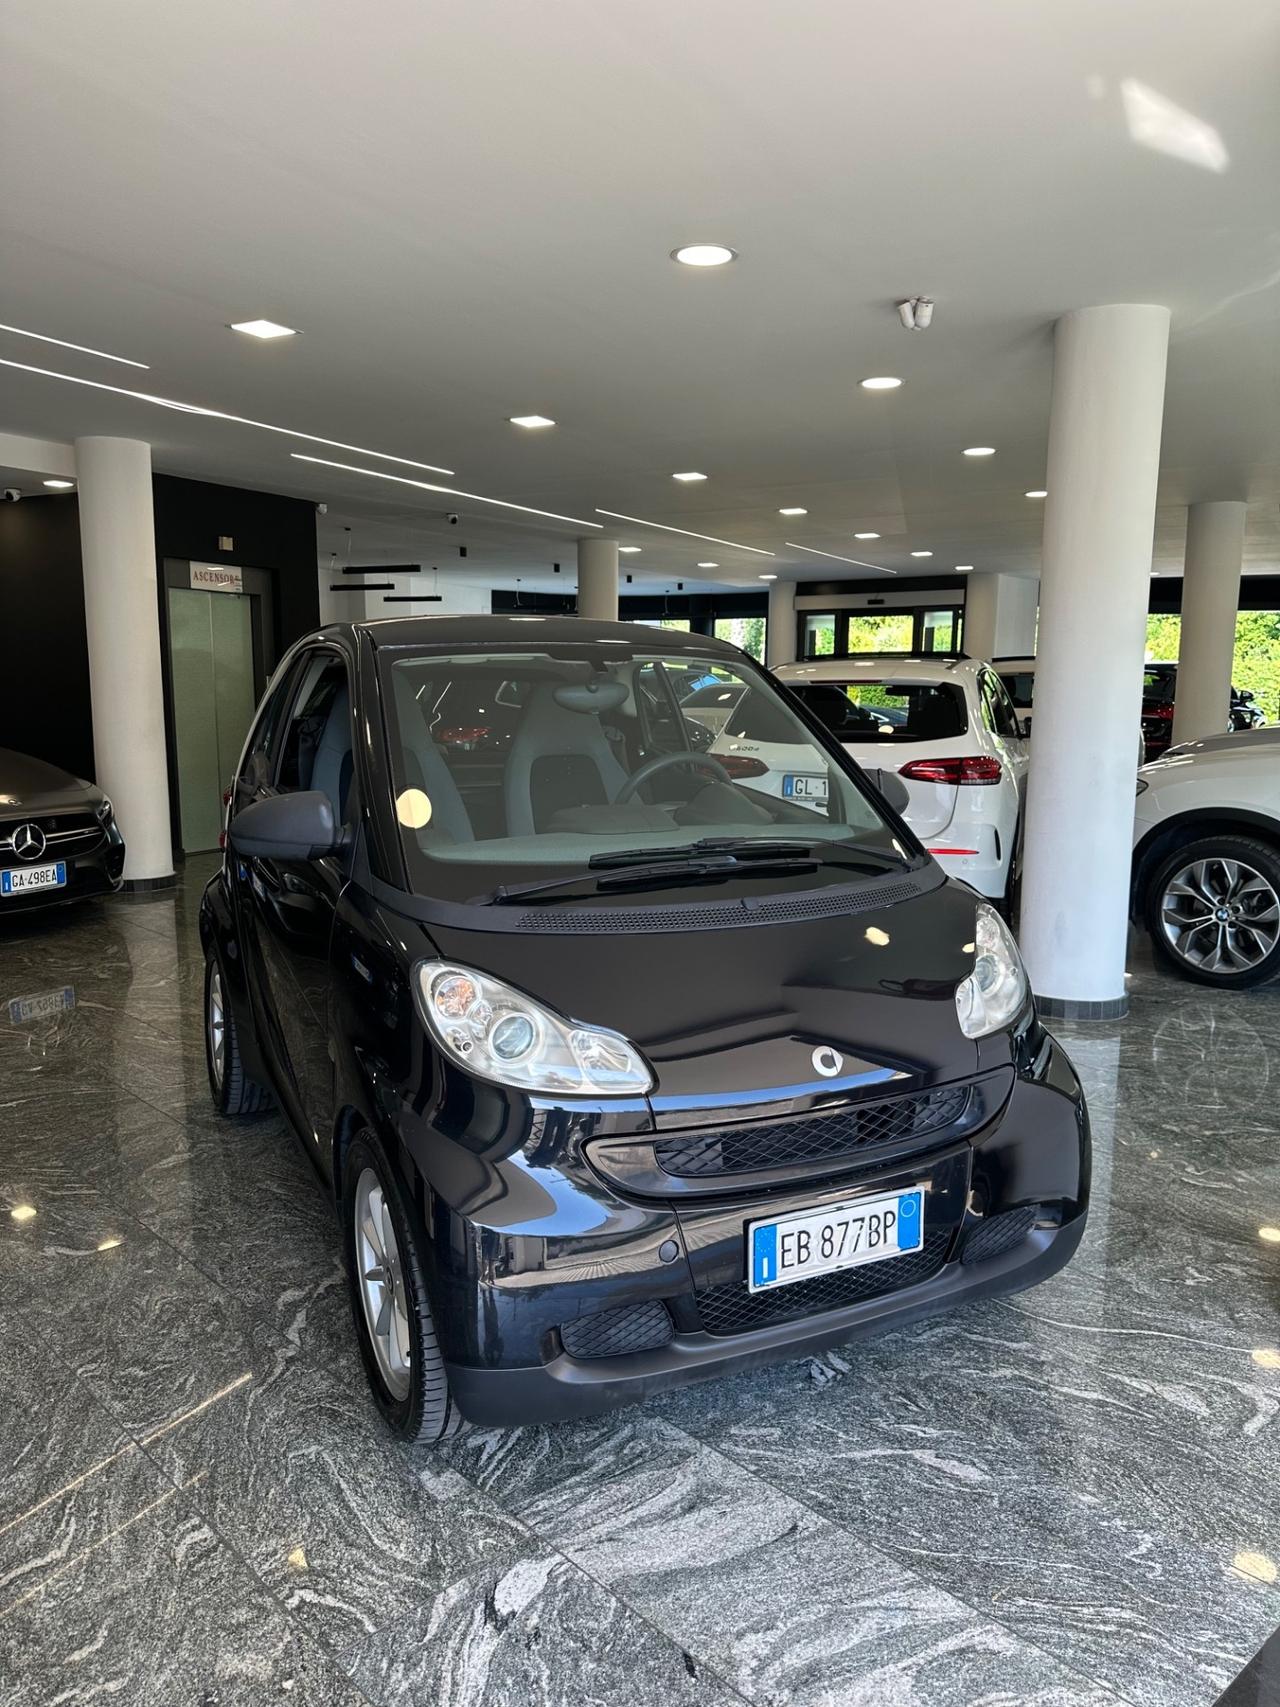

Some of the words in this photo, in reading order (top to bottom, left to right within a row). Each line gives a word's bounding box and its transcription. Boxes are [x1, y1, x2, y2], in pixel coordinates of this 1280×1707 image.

[795, 779, 813, 795] GL
[781, 1229, 811, 1269] EB
[820, 1210, 896, 1259] 877BP
